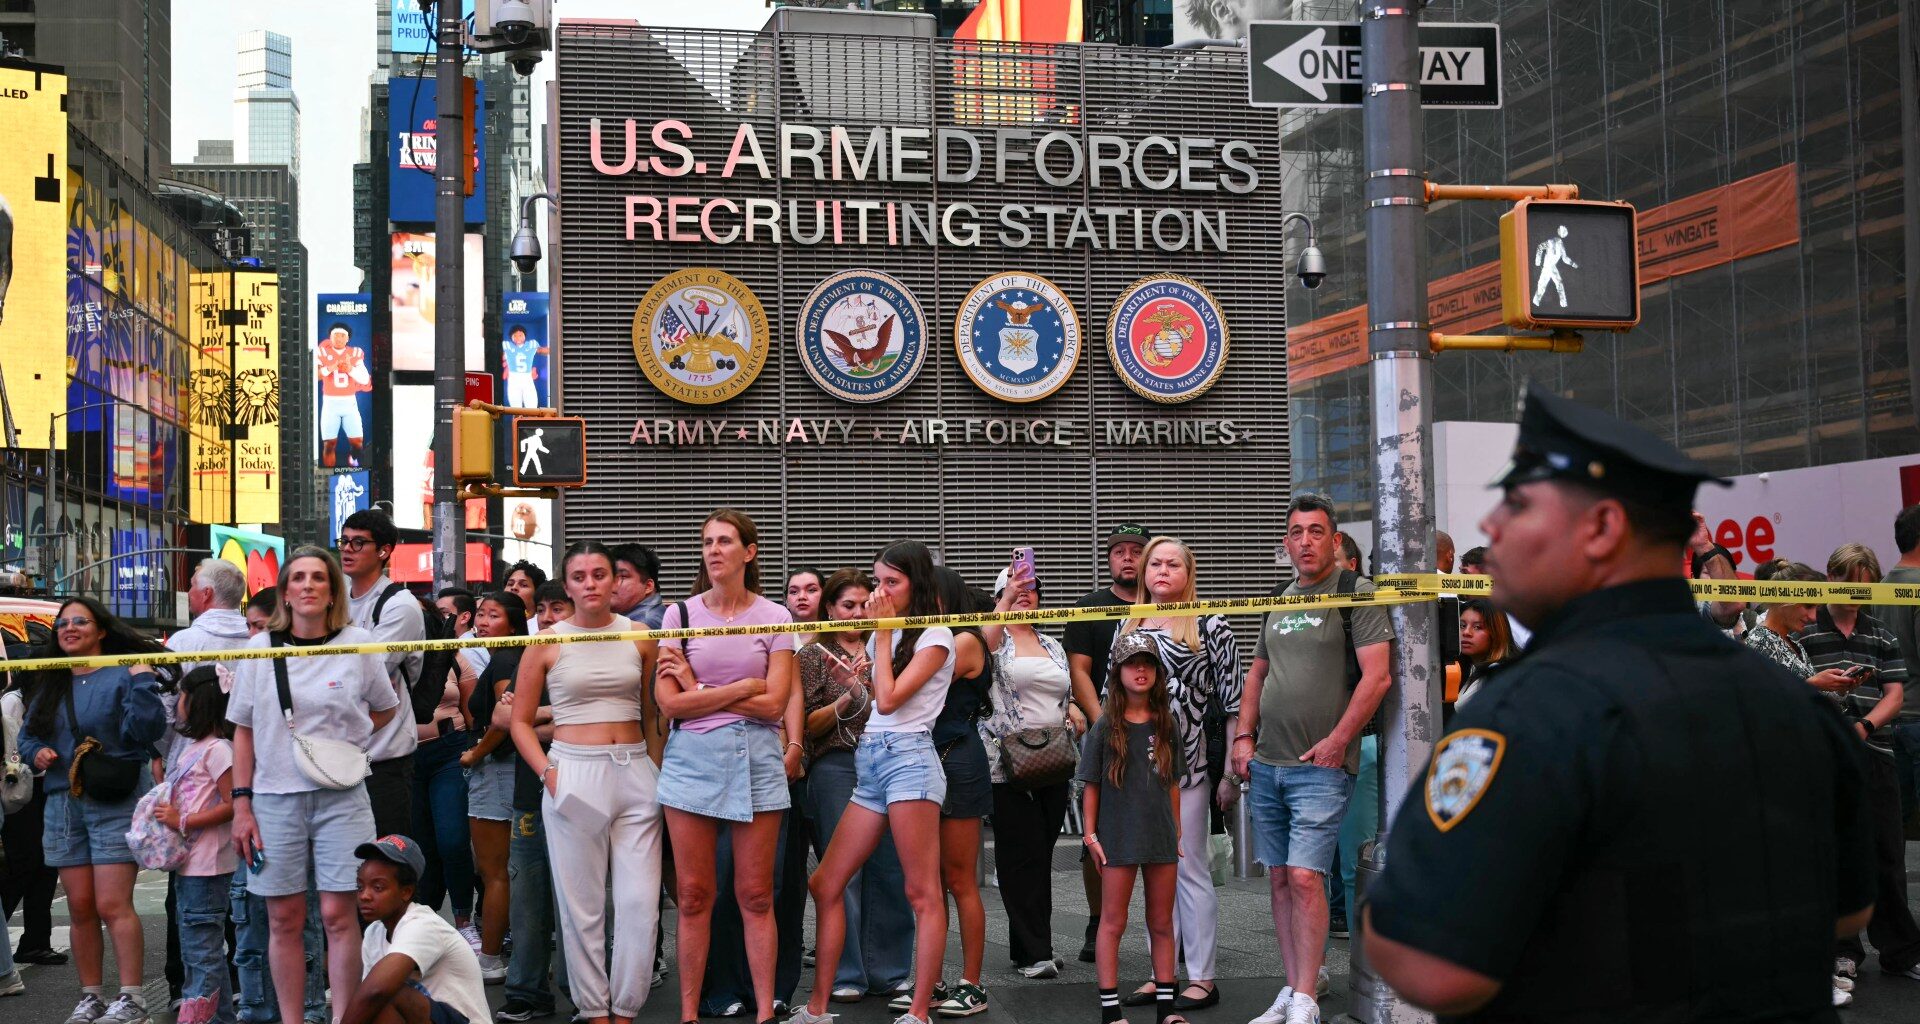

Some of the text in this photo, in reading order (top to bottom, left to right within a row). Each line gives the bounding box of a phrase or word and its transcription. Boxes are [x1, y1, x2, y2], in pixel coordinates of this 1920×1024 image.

[397, 28, 428, 38] PRUD
[1299, 49, 1470, 80] ONE AY
[399, 132, 437, 151] TRIN
[590, 118, 1259, 194] U.S. ARMED FORCES
[625, 196, 1228, 252] RECRUITING STATION
[1664, 218, 1718, 247] WINGATE
[641, 273, 701, 325] DEPARTMENT
[707, 275, 722, 285] OF
[726, 281, 747, 300] THE
[747, 304, 765, 336] ARMY
[809, 281, 915, 333] DEPARTMENT OF THE NAVY
[1117, 285, 1218, 339] DEPARTMENT OF THE NAVY
[250, 315, 262, 329] in
[960, 277, 1077, 363] DEPARTMENT OF THE AIR FORCE
[243, 332, 267, 346] You
[639, 336, 763, 399] UNITED STATES OF AMERICA
[809, 340, 917, 391] UNITED STATES OF AMERICA
[1121, 341, 1218, 390] UNITED STATES MARINE CORPS
[333, 369, 349, 388] 6
[688, 374, 713, 383] 1775
[629, 418, 1236, 446] ARMY NAVY AIR FORCE MARINES
[1706, 516, 1775, 566] ee
[1441, 579, 1461, 589] CROSS
[1462, 579, 1475, 589] NOT
[1475, 579, 1484, 589] DO
[1703, 584, 1712, 594] DO
[1718, 585, 1737, 595] SCENE
[1738, 585, 1756, 596] CRIME
[1759, 586, 1777, 597] (8477)
[1894, 588, 1914, 598] CROSS
[1156, 602, 1177, 611] CROSS
[1177, 601, 1191, 610] NOT
[1191, 601, 1201, 609] DO
[1207, 599, 1228, 608] SCENE
[1229, 599, 1249, 607] CRIME
[904, 617, 926, 625] CROSS
[928, 616, 942, 625] NOT
[958, 613, 979, 623] SCENE
[980, 612, 1000, 622] CRIME
